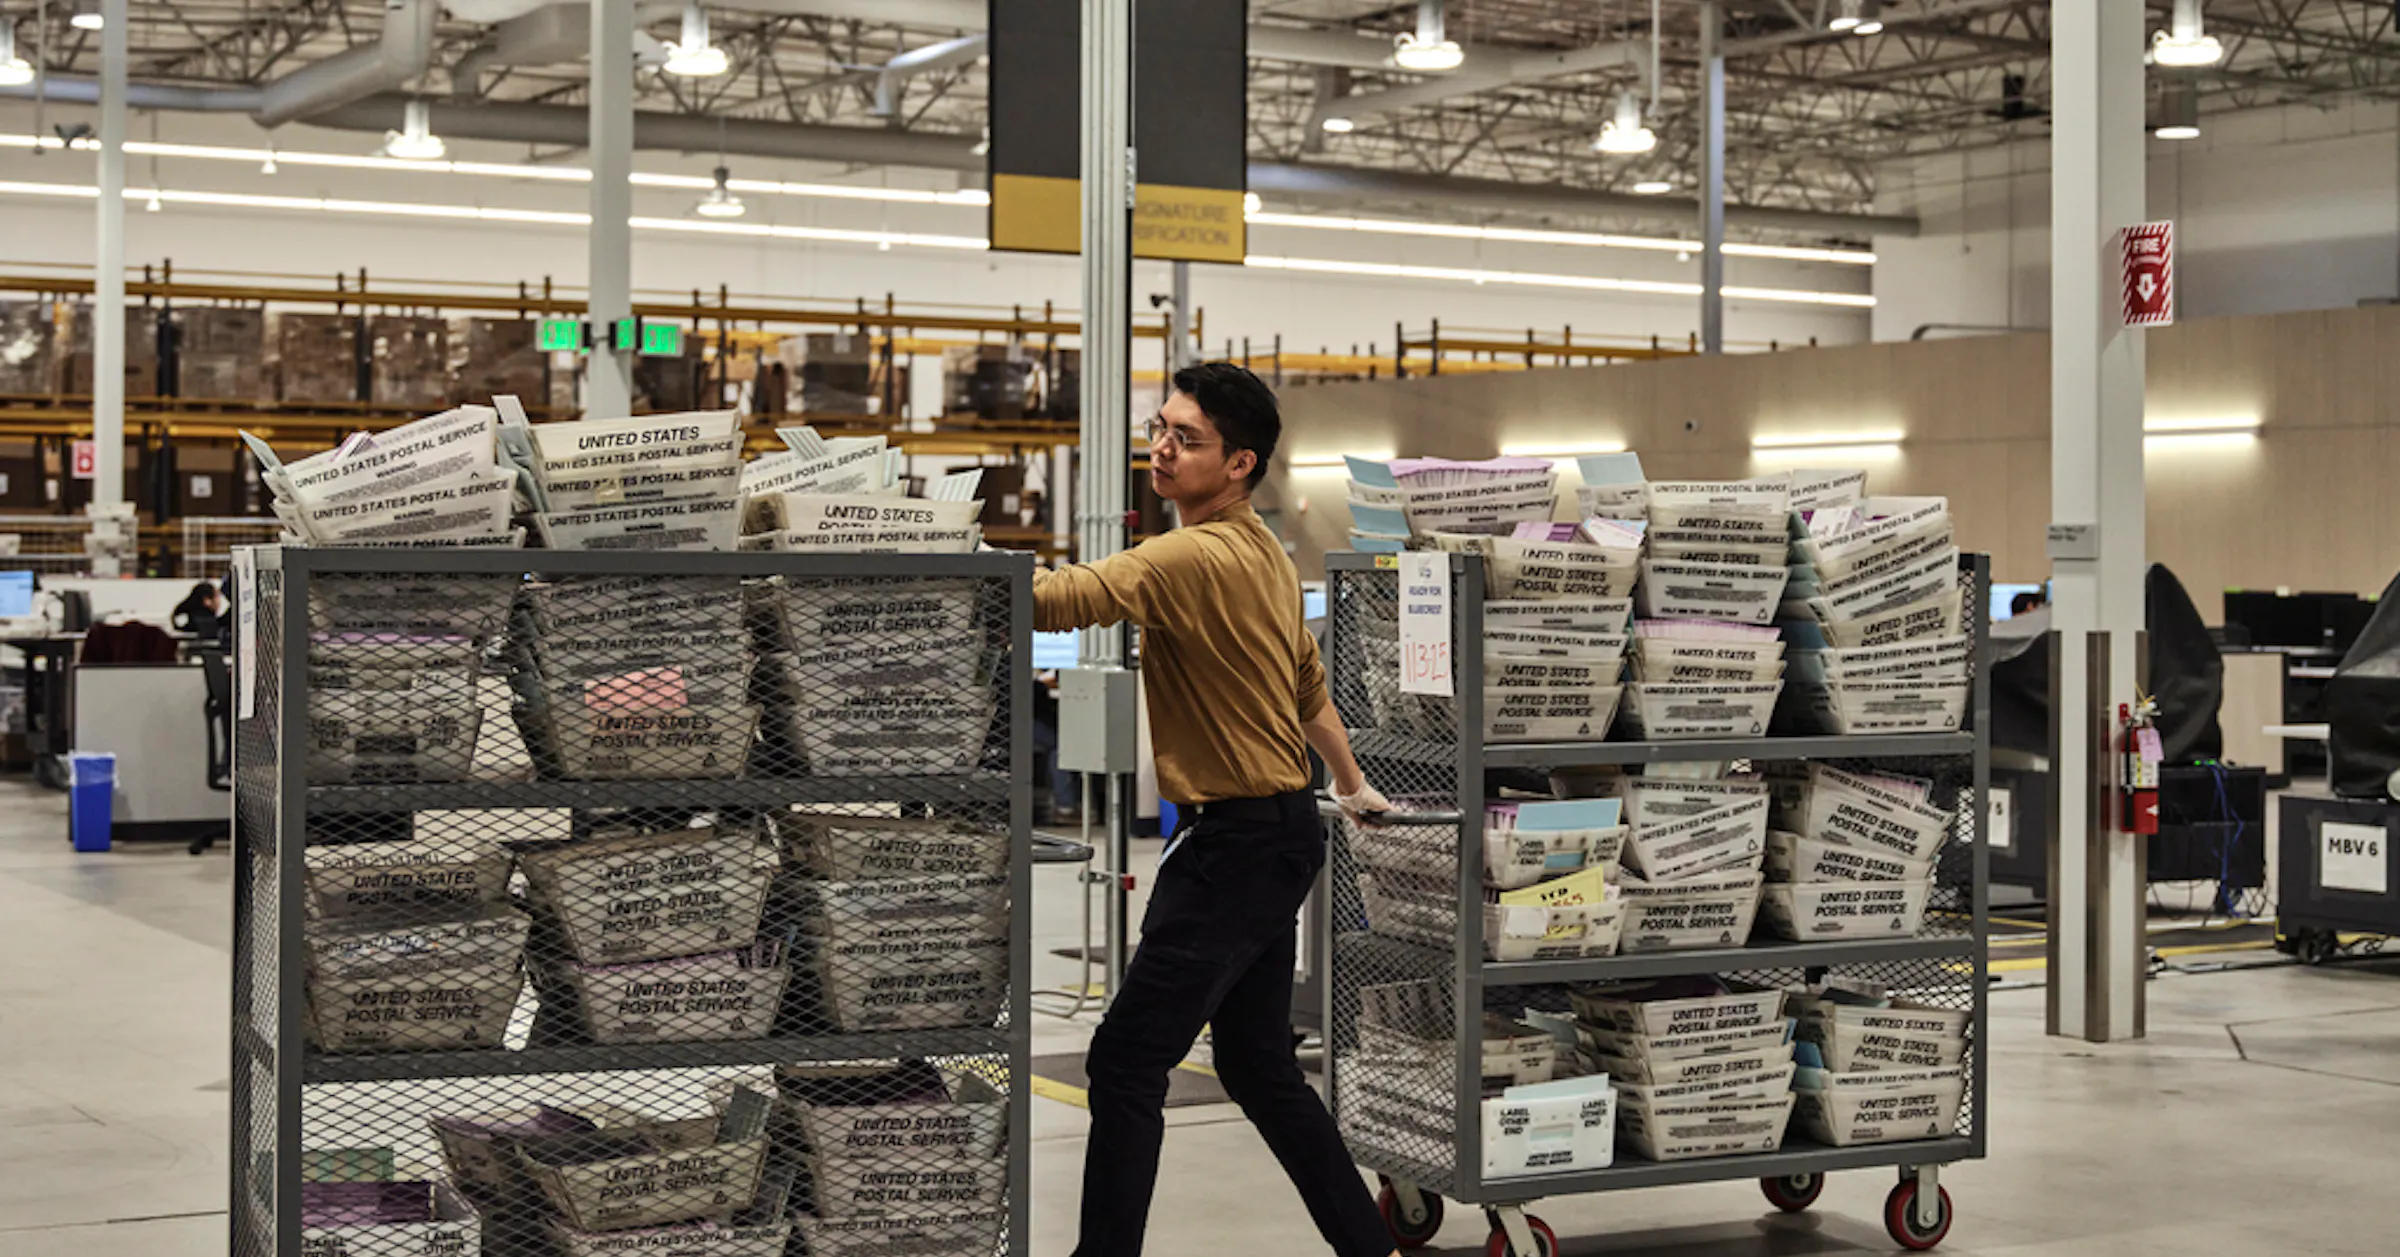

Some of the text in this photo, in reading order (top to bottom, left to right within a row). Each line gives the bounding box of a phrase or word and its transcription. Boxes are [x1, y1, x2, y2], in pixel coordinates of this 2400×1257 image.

[2132, 238, 2160, 253] FIRE
[579, 427, 699, 449] UNITED STATES
[295, 468, 338, 488] UNITED
[342, 456, 387, 476] STATES
[390, 439, 435, 460] POSTAL
[438, 421, 487, 445] SERVICE
[545, 441, 733, 471] UNITED STATES POSTAL SERVICE
[754, 473, 793, 493] STATES
[795, 460, 835, 478] POSTAL
[838, 445, 879, 466] SERVICE
[1411, 480, 1549, 502] UNITED STATES POSTAL SERVICE
[1655, 484, 1688, 492] UNITED
[1722, 485, 1752, 493] POSTAL
[1755, 484, 1787, 492] SERVICE
[313, 479, 509, 520] UNITED STATES POSTAL SERVICE
[549, 500, 736, 526] UNITED STATES POSTAL SERVICE
[825, 505, 934, 523] UNITED STATES
[1818, 503, 1942, 550] UNITED STATES POSTAL SERVICE
[788, 530, 968, 545] UNITED STATES POSTAL SERVICE
[1521, 565, 1607, 582] UNITED STATES
[1652, 566, 1784, 580] UNITED STATES POSTAL SERVICE
[1514, 579, 1611, 597] POSTAL SERVICE
[1486, 604, 1626, 614] UNITED STATES POSTAL SERVICE
[1863, 607, 1940, 635] UNITED STATES
[1861, 617, 1947, 647] POSTAL SERVICE
[1673, 665, 1753, 680] UNITED STATES
[1644, 684, 1776, 694] UNITED STATES POSTAL SERVICE
[1505, 694, 1590, 705] UNITED STATES
[1497, 707, 1596, 717] POSTAL SERVICE
[1632, 781, 1760, 794] UNITED STATES POSTAL SERVICE
[1821, 768, 1945, 822] UNITED STATES POSTAL SERVICE
[1638, 827, 1668, 842] UNITED
[1670, 818, 1699, 834] STATES
[1701, 810, 1730, 825] POSTAL
[1732, 799, 1763, 817] SERVICE
[1837, 803, 1877, 826] UNITED
[1879, 818, 1919, 841] STATES
[1828, 814, 1869, 839] POSTAL
[1873, 831, 1918, 855] SERVICE
[2329, 837, 2378, 856] MBV 6
[1820, 890, 1904, 903] UNITED STATES
[1646, 903, 1734, 916] UNITED STATES
[1814, 903, 1907, 917] POSTAL SERVICE
[1639, 917, 1737, 930] POSTAL SERVICE
[1673, 1003, 1759, 1021] UNITED STATES
[1667, 1016, 1762, 1035] POSTAL SERVICE
[1862, 1034, 1938, 1053] UNITED STATES
[1854, 1047, 1942, 1066] POSTAL SERVICE
[1654, 1070, 1787, 1097] UNITED STATES POSTAL SERVICE
[1582, 1100, 1606, 1109] LABEL
[1860, 1095, 1936, 1109] UNITED STATES
[1501, 1108, 1529, 1116] LABEL
[1580, 1108, 1607, 1118] OTHER
[1854, 1107, 1939, 1123] POSTAL SERVICE
[854, 1116, 970, 1130] UNITED STATES
[1500, 1118, 1529, 1126] OTHER
[1584, 1118, 1600, 1127] END
[1504, 1127, 1524, 1135] END
[847, 1133, 974, 1147] POSTAL SERVICE
[861, 1172, 977, 1185] UNITED STATES
[854, 1188, 982, 1201] POSTAL SERVICE
